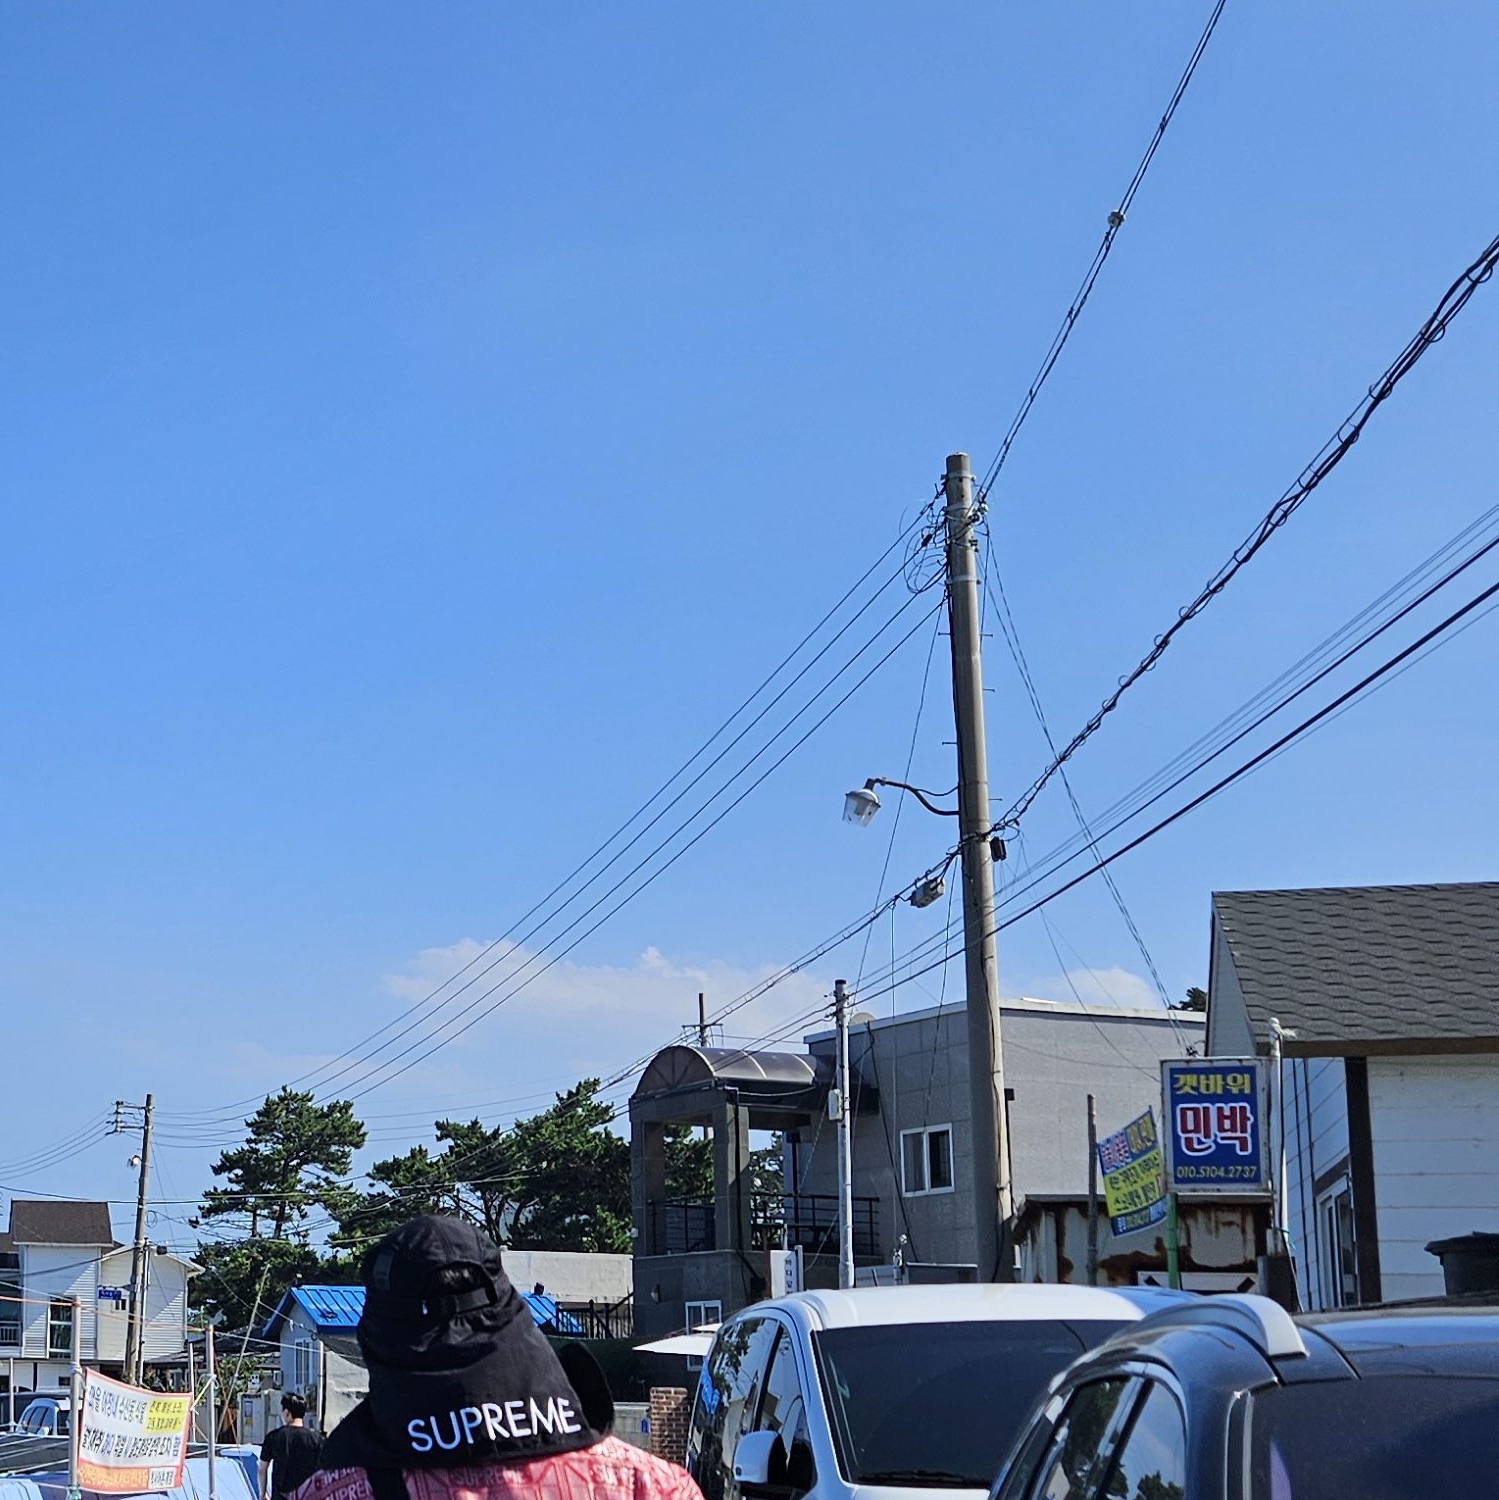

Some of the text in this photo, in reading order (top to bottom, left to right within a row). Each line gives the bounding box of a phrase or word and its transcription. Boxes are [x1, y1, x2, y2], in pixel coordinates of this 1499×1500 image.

[1173, 1073, 1251, 1095] 갯바위
[1177, 1103, 1254, 1155] 민박
[1177, 1166, 1257, 1178] 010.5104.2737
[407, 1397, 582, 1452] SUPREME
